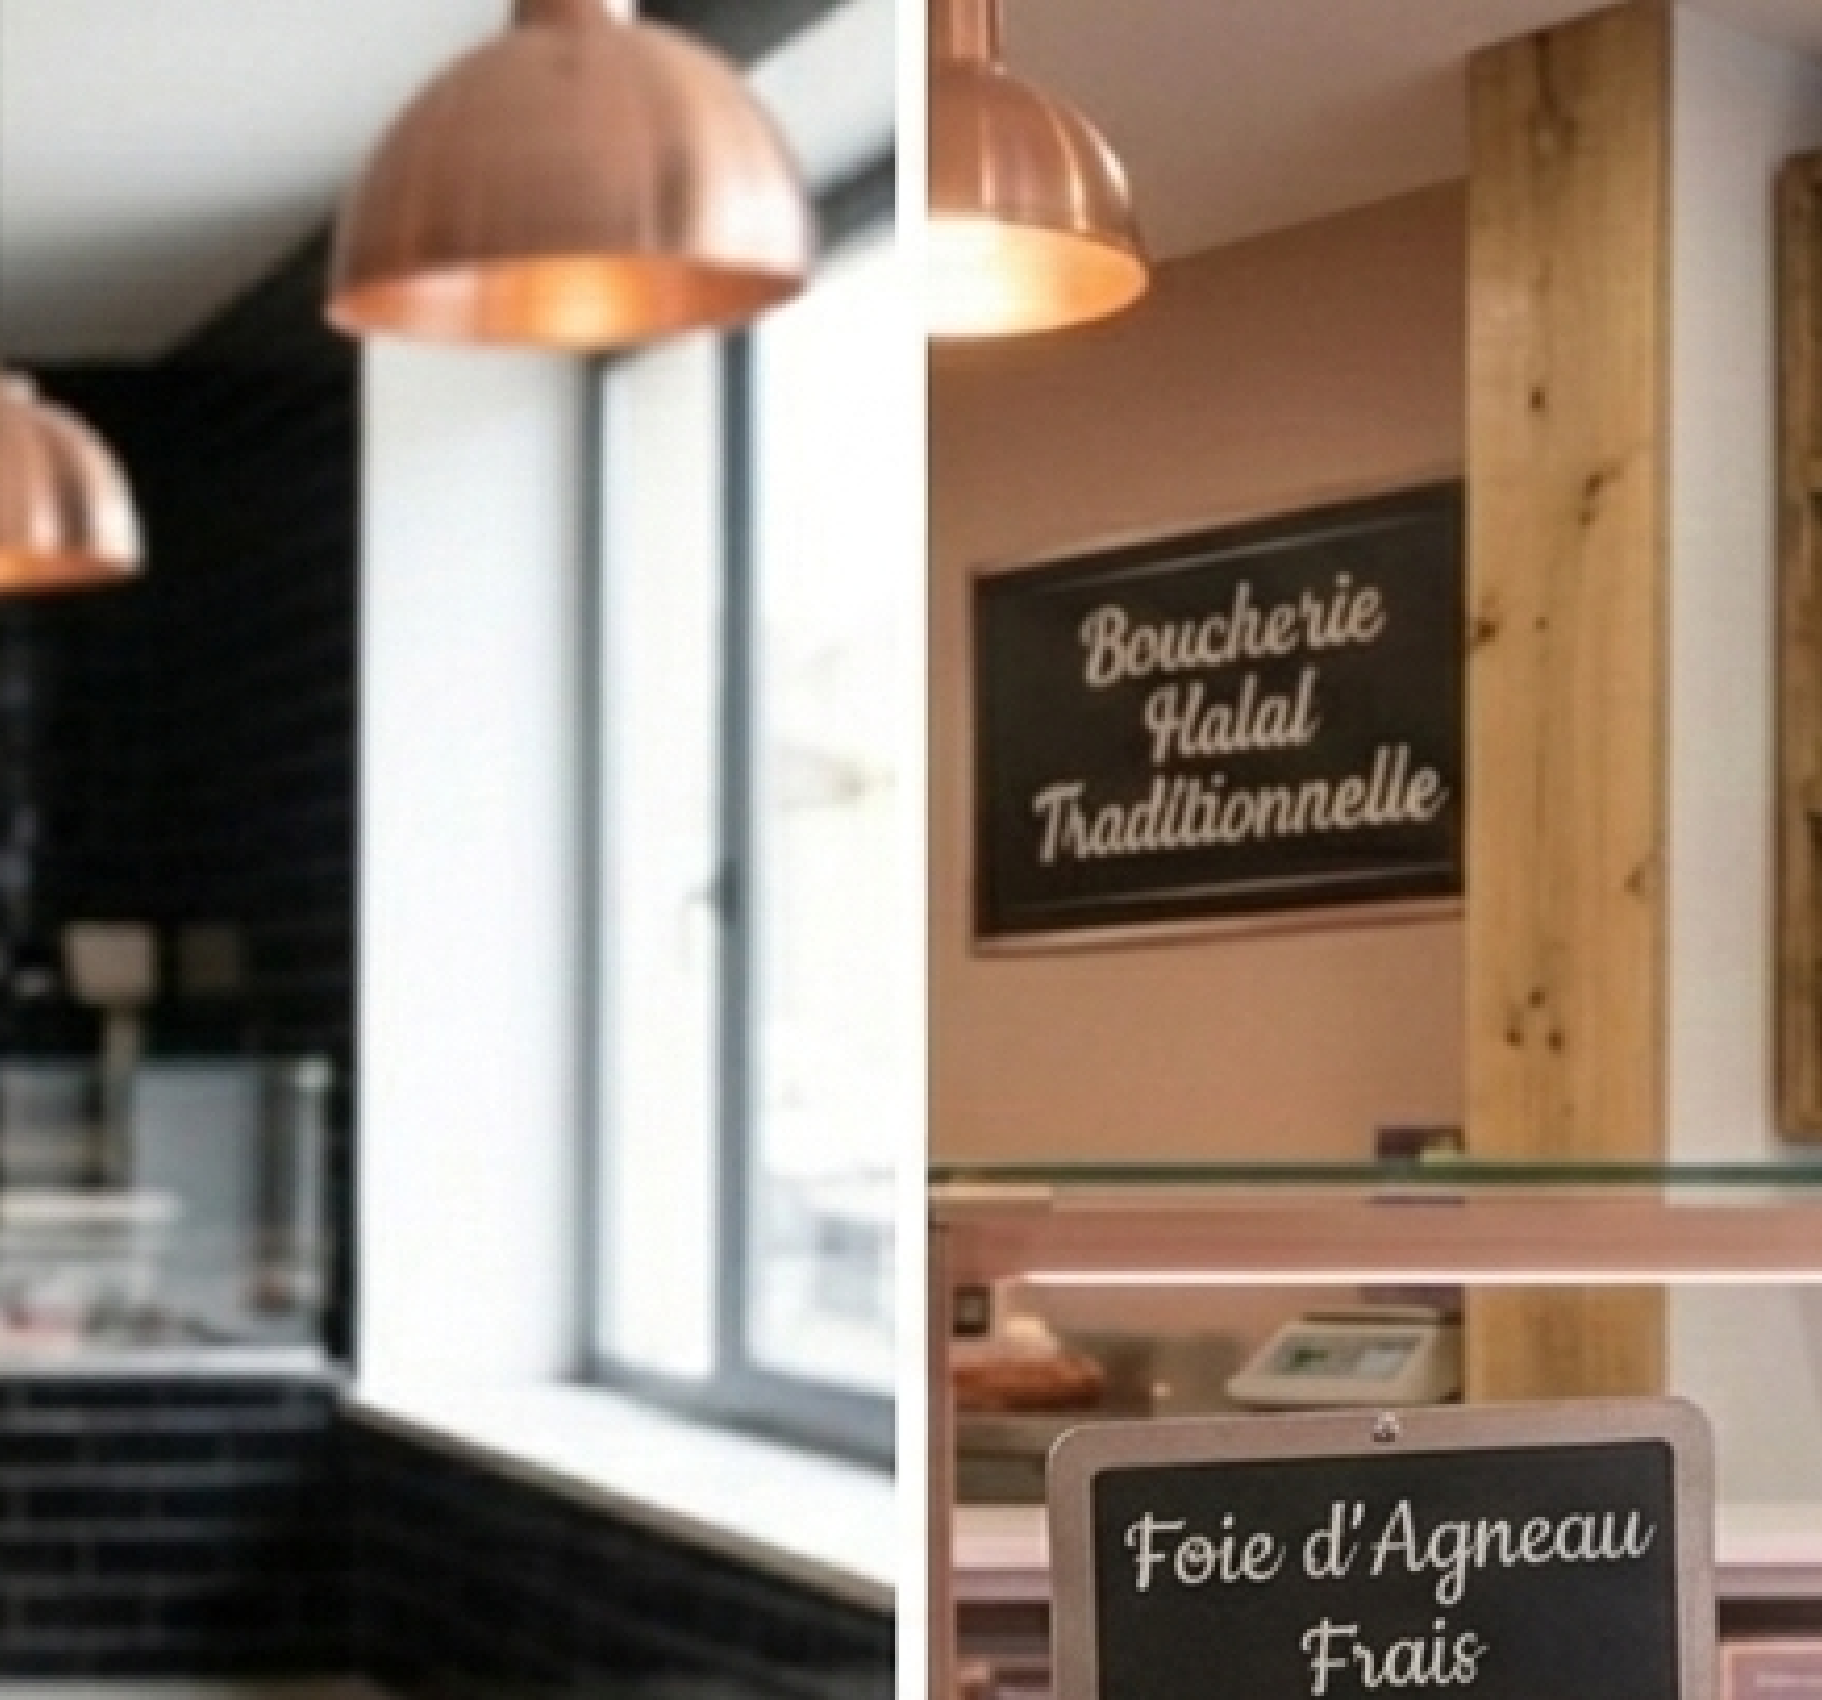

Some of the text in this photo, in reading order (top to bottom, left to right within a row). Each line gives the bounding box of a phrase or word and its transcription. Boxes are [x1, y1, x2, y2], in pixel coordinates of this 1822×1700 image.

[1082, 571, 1386, 688] Boucherie
[1143, 665, 1323, 765] Halal
[1032, 743, 1448, 866] Traditionnelle
[1124, 1499, 1657, 1606] Foie d'Agneau
[1301, 1615, 1489, 1697] Frais
